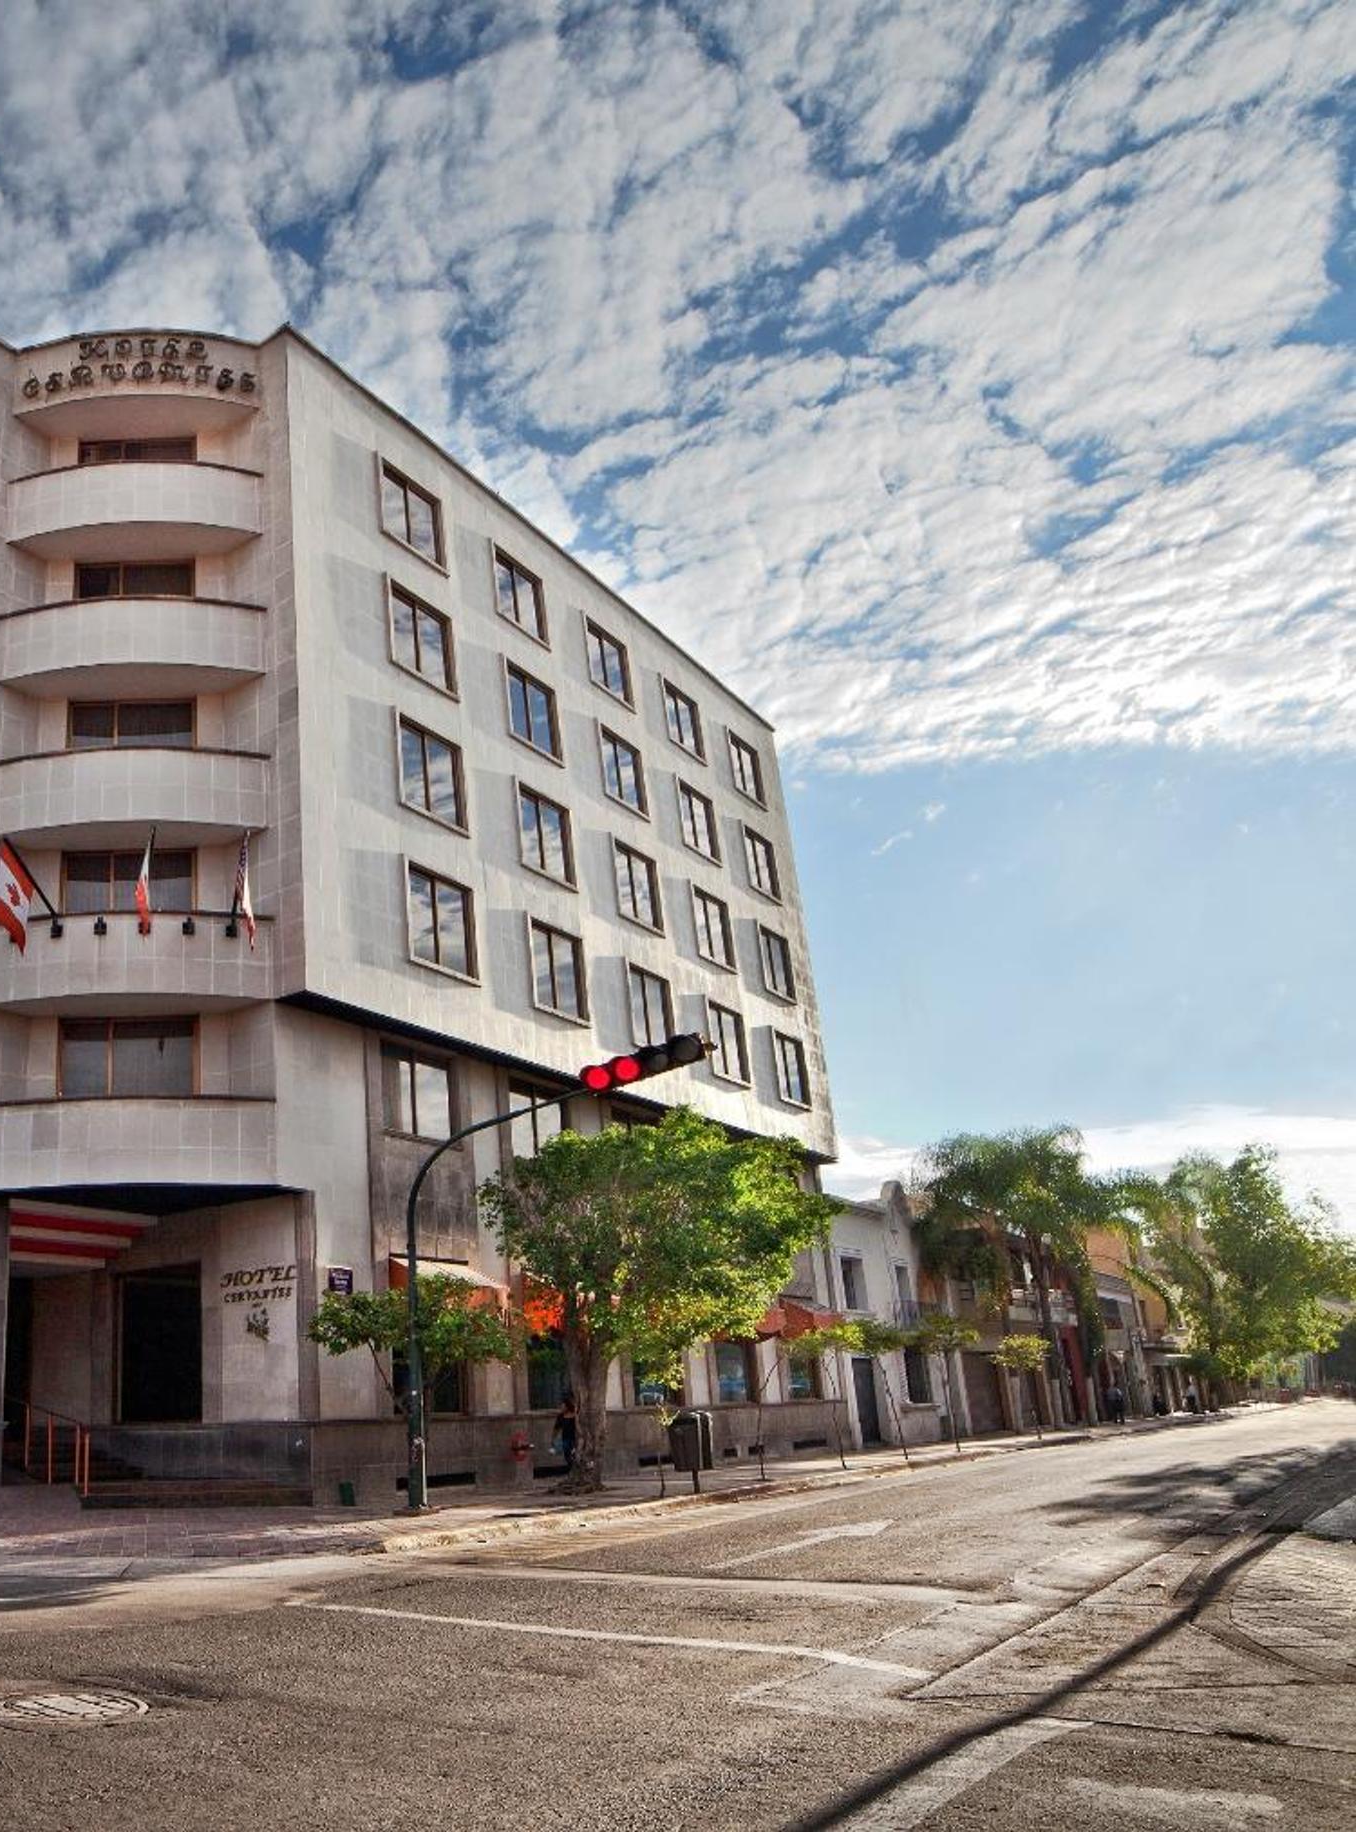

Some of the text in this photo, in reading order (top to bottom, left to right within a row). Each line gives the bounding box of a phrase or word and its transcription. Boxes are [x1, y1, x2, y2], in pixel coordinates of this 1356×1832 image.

[79, 338, 209, 361] HOTEL
[22, 361, 257, 398] CERVANTES
[220, 1265, 297, 1288] HOTEL
[224, 1286, 292, 1303] CERVANTES
